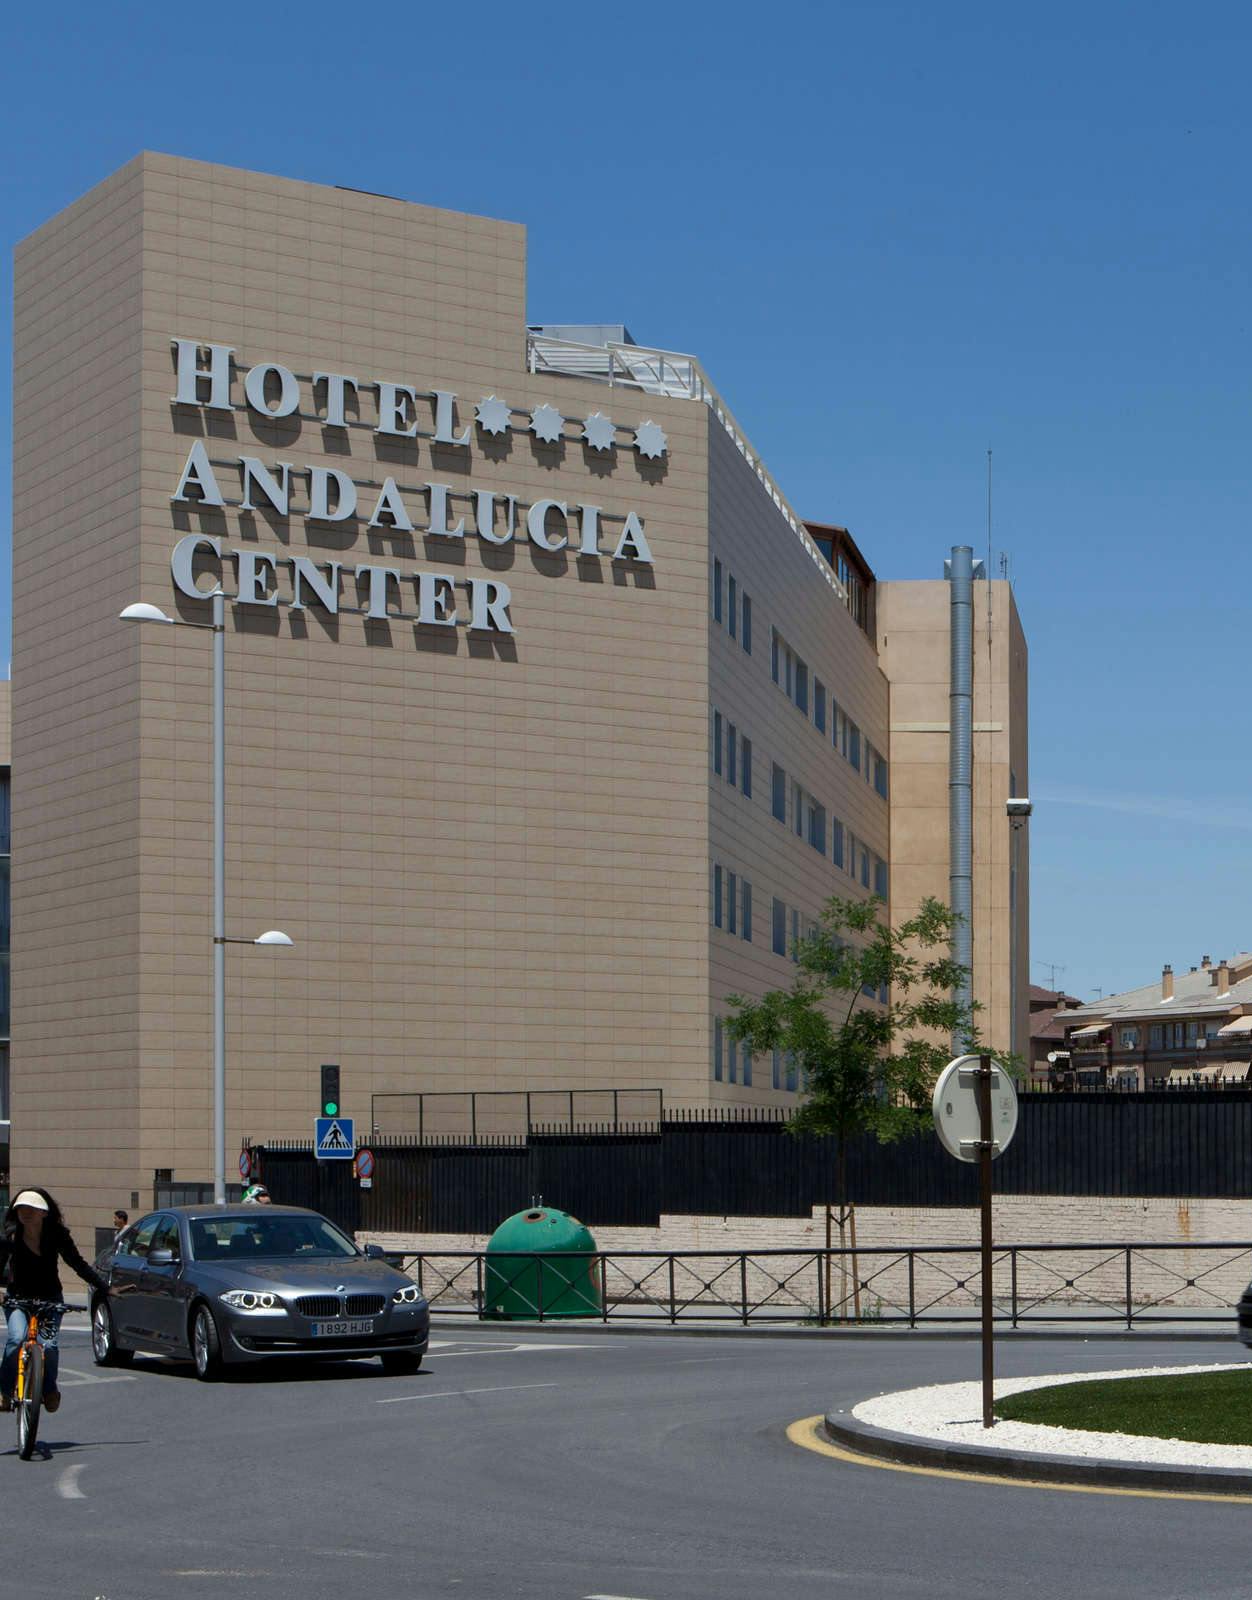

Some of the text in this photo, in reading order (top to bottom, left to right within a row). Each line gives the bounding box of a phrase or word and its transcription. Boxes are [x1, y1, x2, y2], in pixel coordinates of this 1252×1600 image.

[170, 337, 472, 446] HOTEL
[171, 439, 656, 564] ANDALUCIA
[170, 533, 516, 634] CENTER
[320, 1323, 347, 1335] 1892
